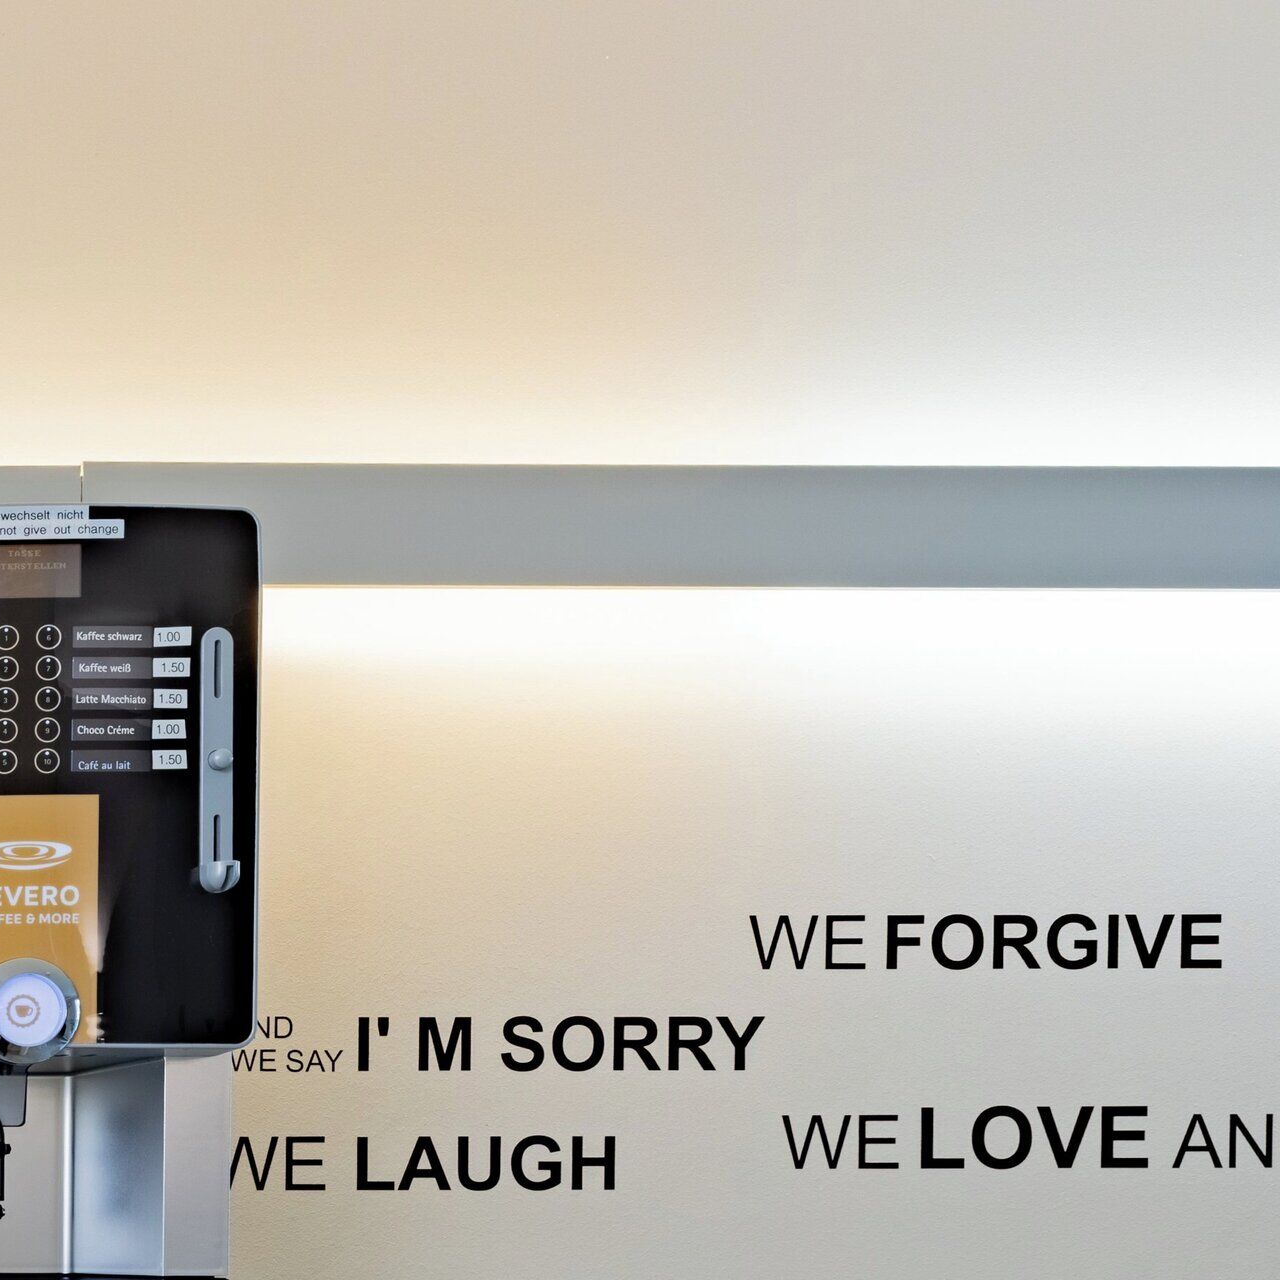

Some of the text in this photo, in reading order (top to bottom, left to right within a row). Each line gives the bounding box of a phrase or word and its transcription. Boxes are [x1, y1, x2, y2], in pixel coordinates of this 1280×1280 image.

[0, 510, 50, 521] wechselt
[57, 510, 84, 520] nicht
[0, 526, 16, 536] not
[23, 526, 47, 537] give
[53, 526, 71, 535] out
[77, 524, 119, 537] change
[8, 550, 41, 558] TASSE
[76, 631, 142, 641] Kaffee schwarz
[158, 631, 181, 642] 1.00
[79, 663, 131, 673] Kaffee weiß
[161, 662, 185, 672] 1.50
[75, 695, 147, 704] Latte Macchiato
[159, 694, 182, 704] 1.50
[77, 725, 105, 735] Choco
[157, 724, 180, 734] 1.00
[78, 760, 99, 770] Café
[115, 761, 130, 770] lait
[158, 755, 182, 765] 1.50
[26, 913, 35, 925] &
[39, 912, 80, 925] MORE
[749, 913, 1223, 971] WE FORGIVE
[255, 1016, 294, 1039] ND
[232, 1049, 277, 1073] WE
[285, 1049, 343, 1073] SAY
[500, 1015, 766, 1073] SORRY
[781, 1114, 900, 1170] WE
[920, 1105, 1149, 1170] LOVE
[230, 1134, 617, 1191] WE LAUGH
